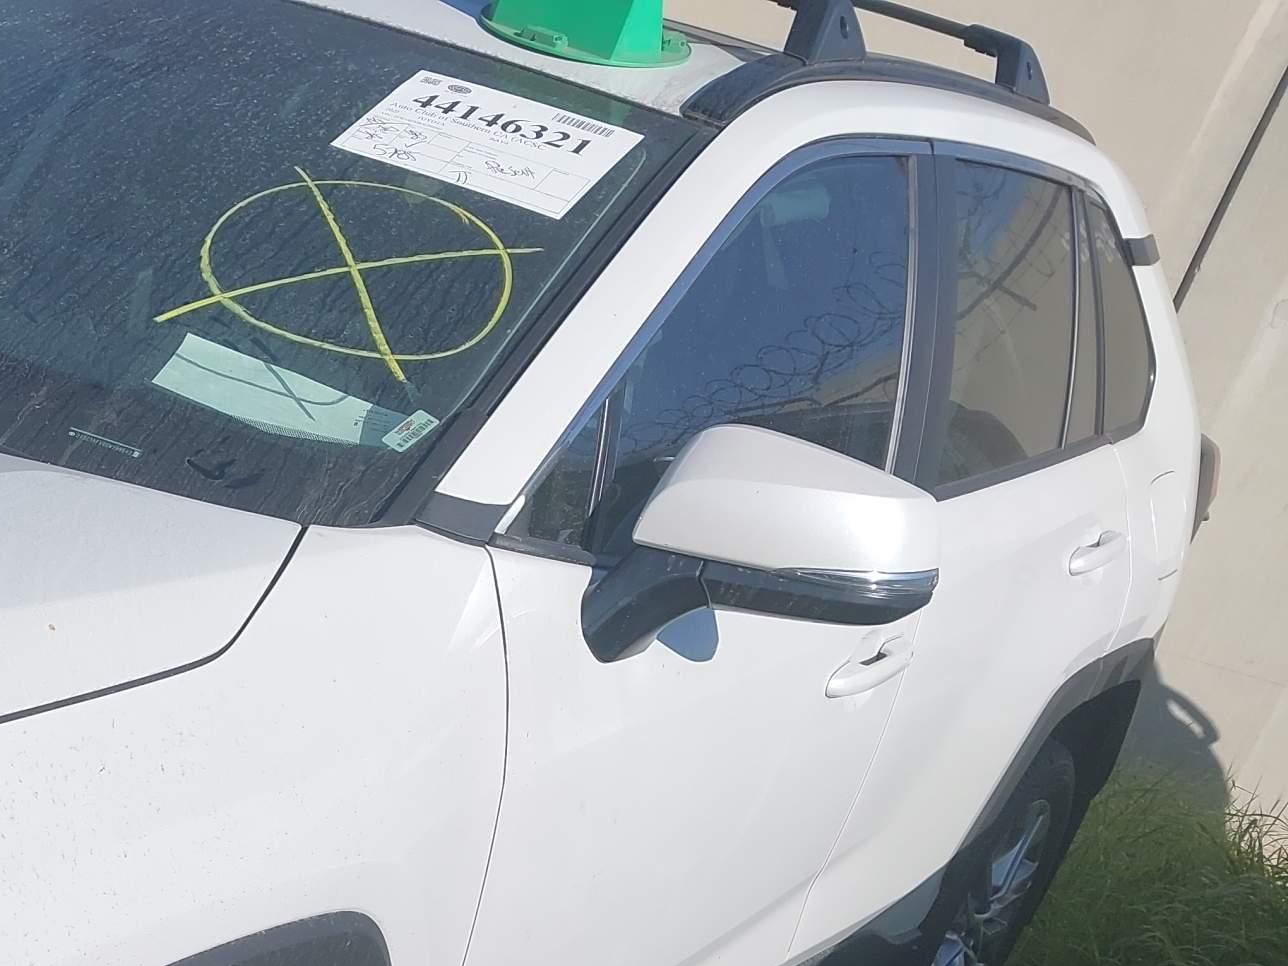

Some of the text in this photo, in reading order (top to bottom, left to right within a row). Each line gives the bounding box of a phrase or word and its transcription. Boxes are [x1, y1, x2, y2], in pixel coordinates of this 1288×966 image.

[390, 102, 413, 111] Auto
[415, 107, 437, 118] Club
[452, 117, 491, 134] Southern
[411, 94, 593, 156] 44146321
